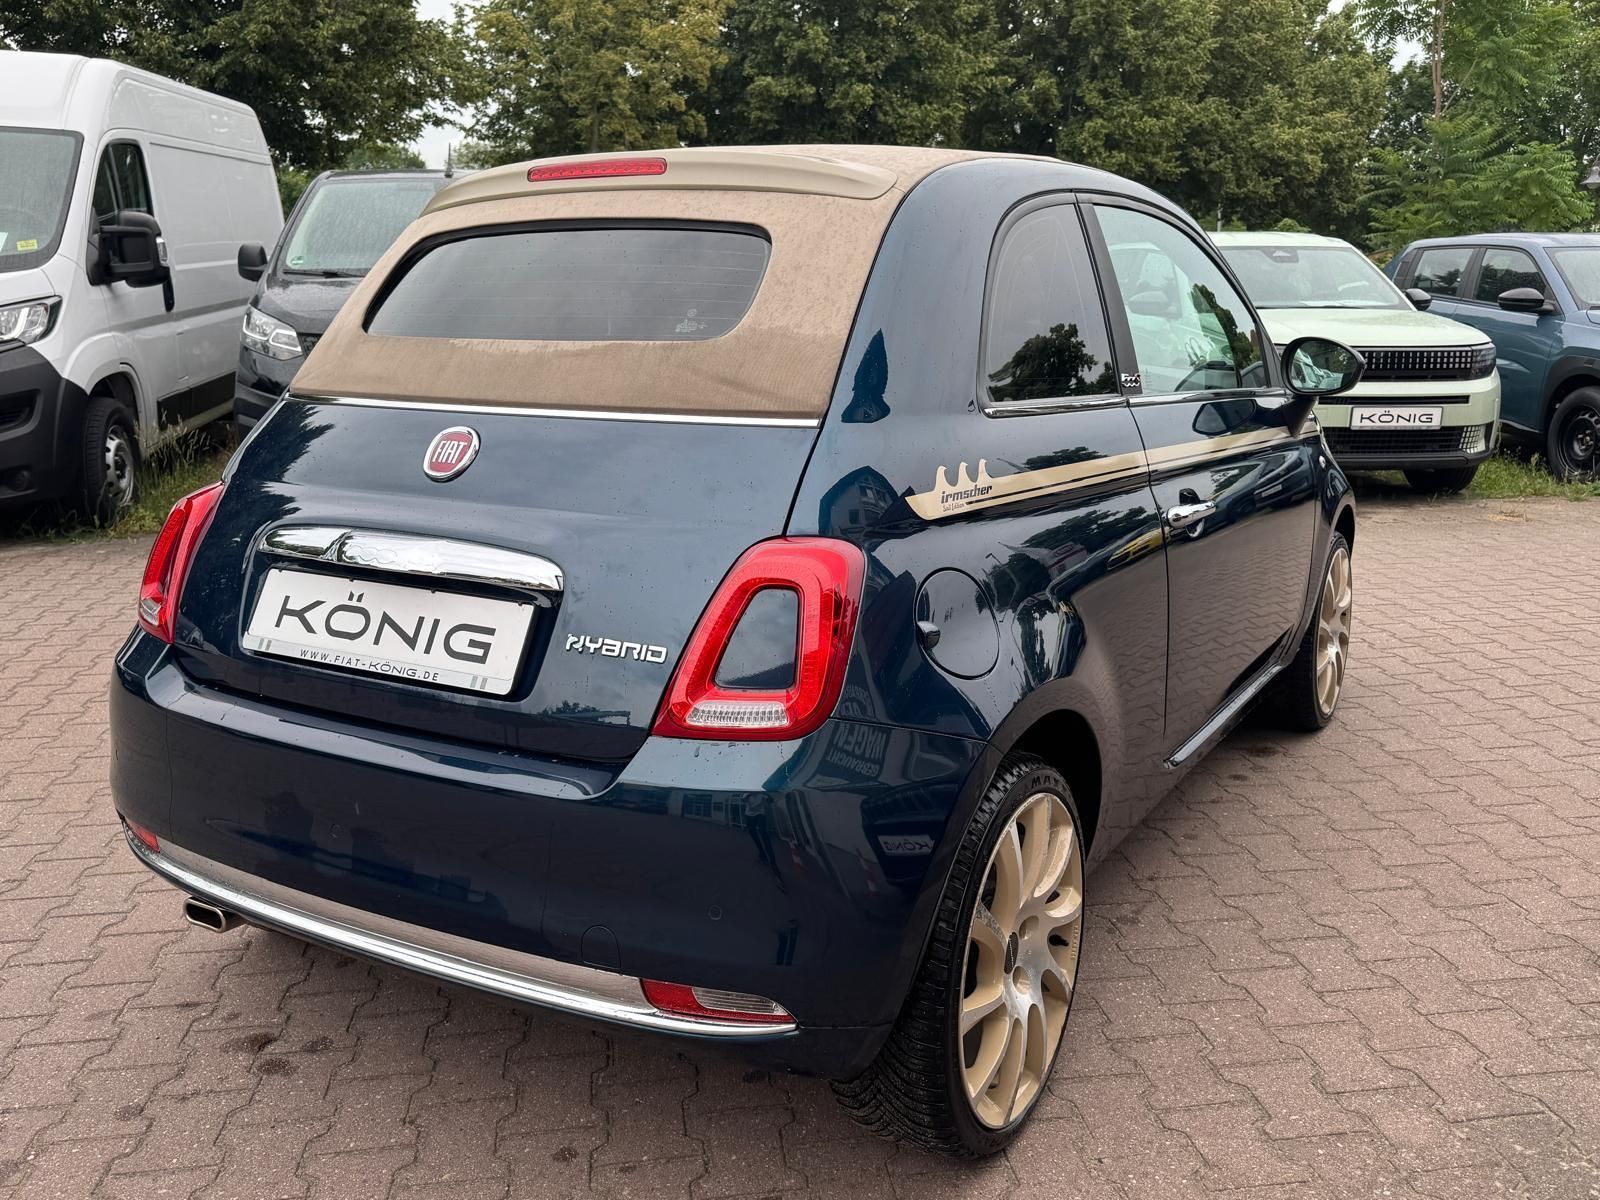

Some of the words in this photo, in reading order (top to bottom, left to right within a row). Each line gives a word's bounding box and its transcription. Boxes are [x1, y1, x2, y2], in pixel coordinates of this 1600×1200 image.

[1359, 409, 1434, 424] KÖNIG
[431, 440, 468, 464] FIAT
[940, 484, 993, 504] irmscher
[273, 590, 497, 665] KÖNIG
[565, 633, 668, 664] HYBRID
[299, 648, 440, 682] WWW.FIAT-KÖNIG.DE
